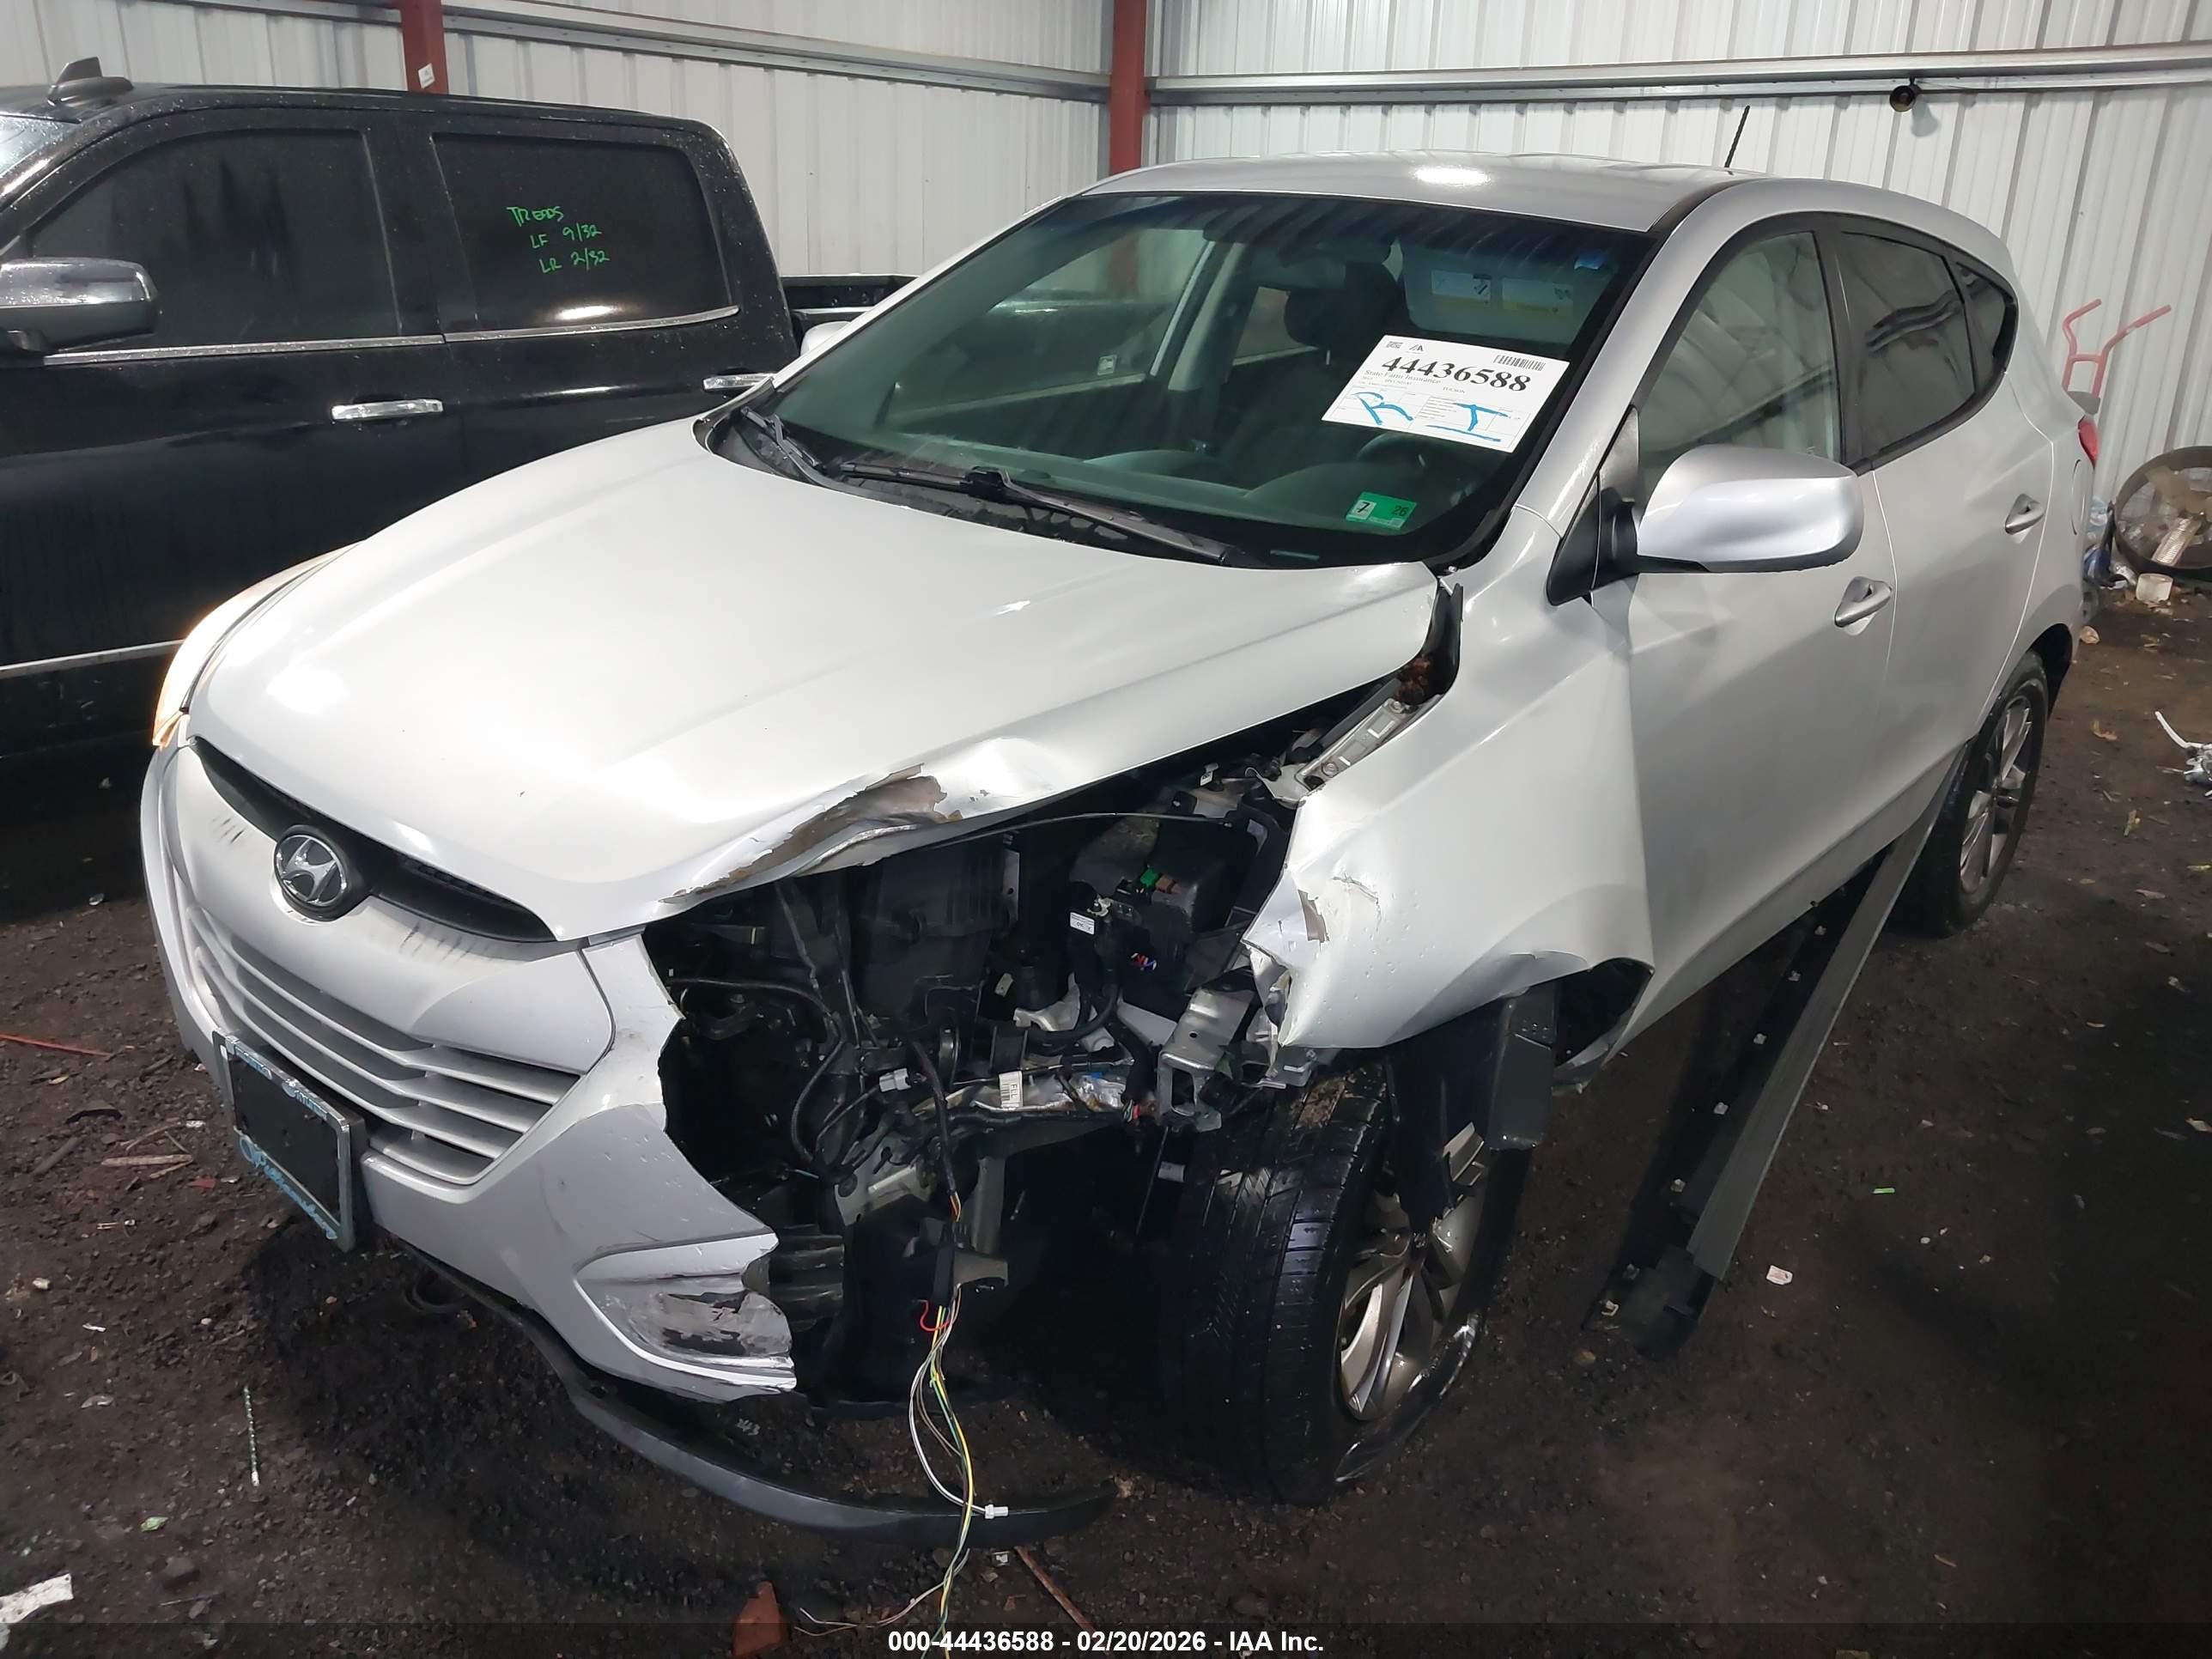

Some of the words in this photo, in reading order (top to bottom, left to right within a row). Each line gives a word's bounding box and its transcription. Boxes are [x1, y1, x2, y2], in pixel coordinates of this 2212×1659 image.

[530, 234, 550, 248] LF
[562, 222, 602, 241] 9/32
[538, 258, 562, 273] LR
[571, 247, 611, 271] 2/32
[1382, 356, 1530, 392] 44436588
[1357, 501, 1370, 514] 7
